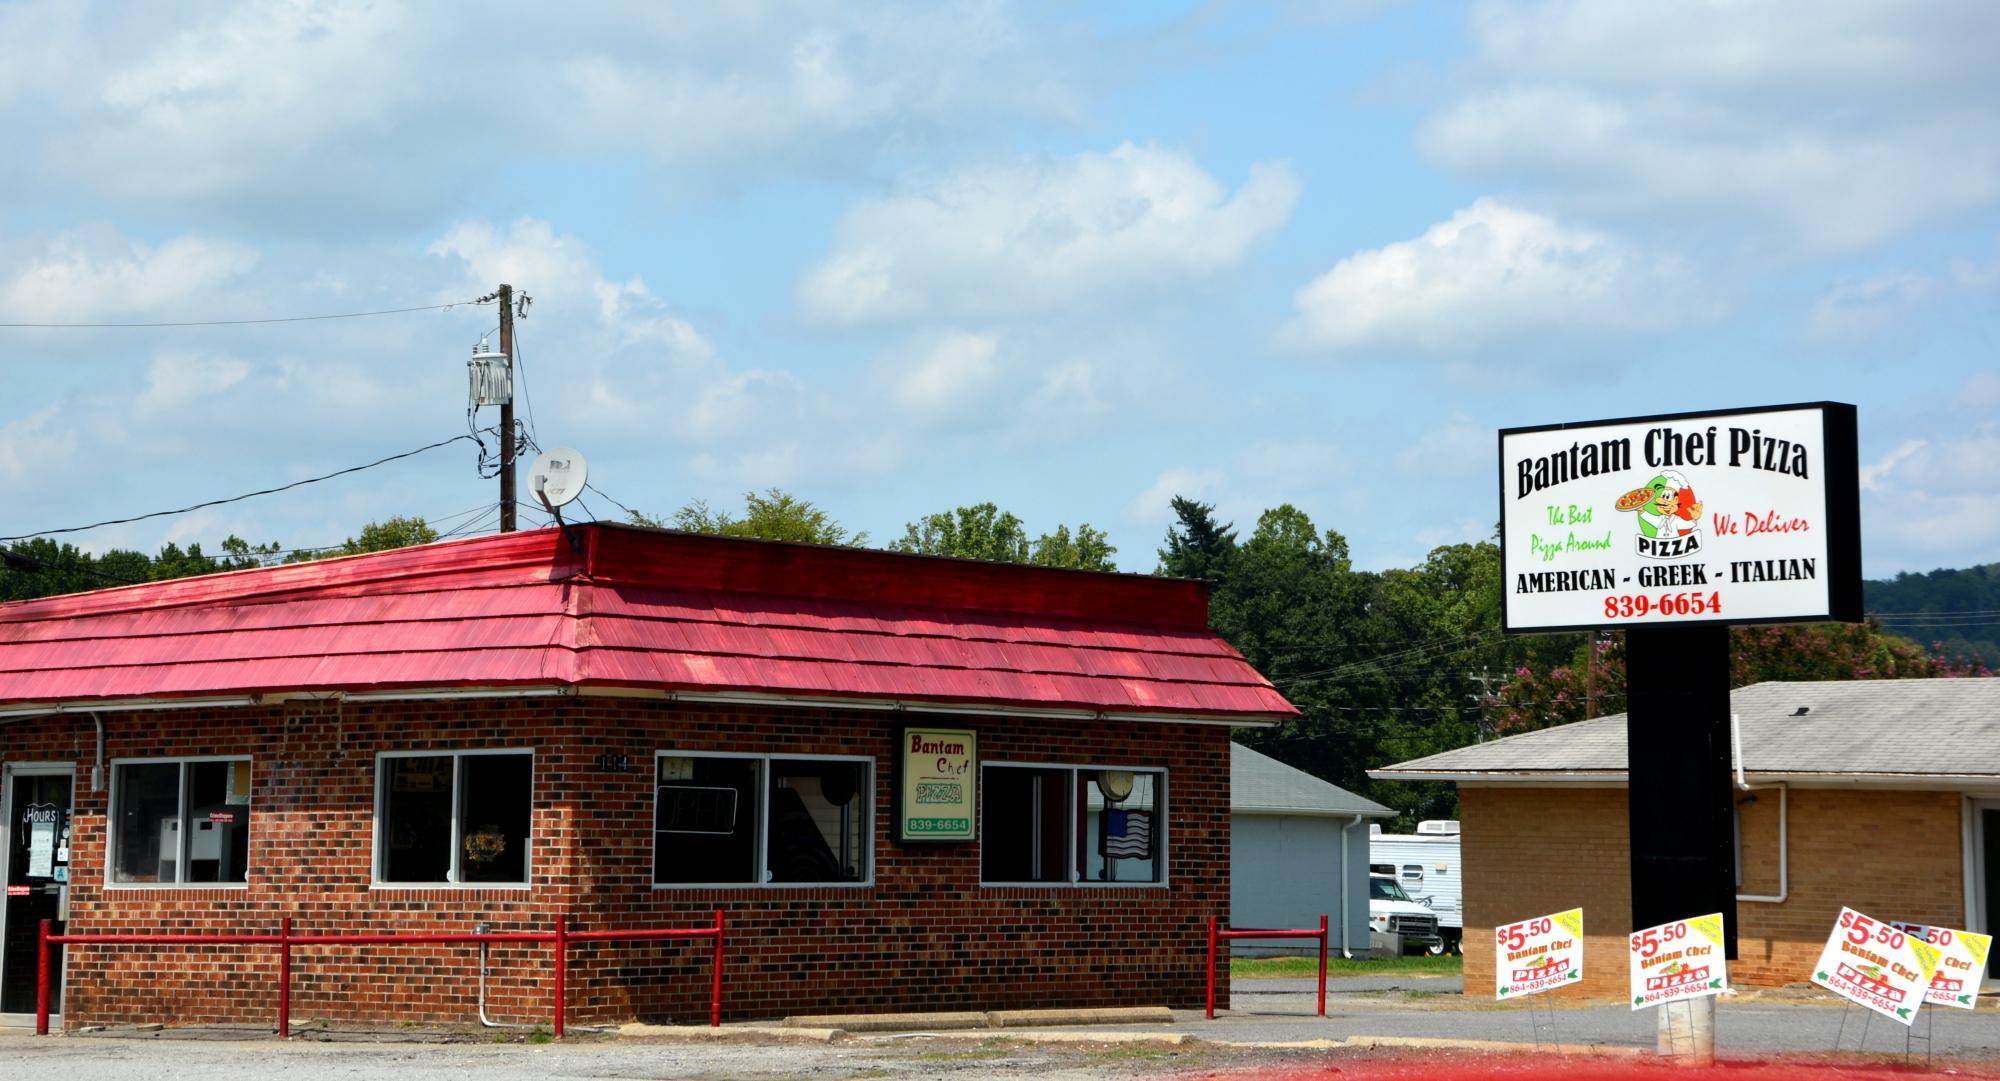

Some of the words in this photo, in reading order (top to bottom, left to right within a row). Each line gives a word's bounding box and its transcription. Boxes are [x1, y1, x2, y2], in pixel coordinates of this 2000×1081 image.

[1518, 438, 1631, 500] Bantam
[1644, 426, 1717, 467] Chef
[1729, 428, 1808, 480] Pizza
[1547, 505, 1565, 526] The
[1568, 504, 1593, 525] Best
[1713, 512, 1738, 536] We
[1745, 510, 1810, 536] Deliver
[1531, 533, 1563, 561] Pizza
[1566, 530, 1612, 553] Around
[1638, 535, 1699, 557] PIZZA
[1516, 568, 1615, 594] AMERICAN
[1638, 563, 1708, 587] GREEK
[1730, 558, 1816, 583] ITALIAN
[1603, 591, 1721, 619] 839-6654
[911, 735, 964, 755] Bantam
[936, 757, 969, 775] Chef
[910, 820, 967, 830] 839-6654
[1497, 918, 1551, 950] $5.50
[1631, 922, 1687, 957] $5.50
[1840, 912, 1905, 950] $5.50
[1507, 945, 1547, 962] Bantam
[1551, 938, 1573, 951] Chef
[1641, 950, 1682, 969] Bantam
[1686, 945, 1712, 957] Chef
[1841, 940, 1889, 967] Bantam
[1891, 962, 1919, 982] Chef
[1510, 973, 1567, 993] 864-839-6654
[1645, 982, 1708, 1003] 864-839-6654
[1828, 976, 1896, 1013] 864-839-6654
